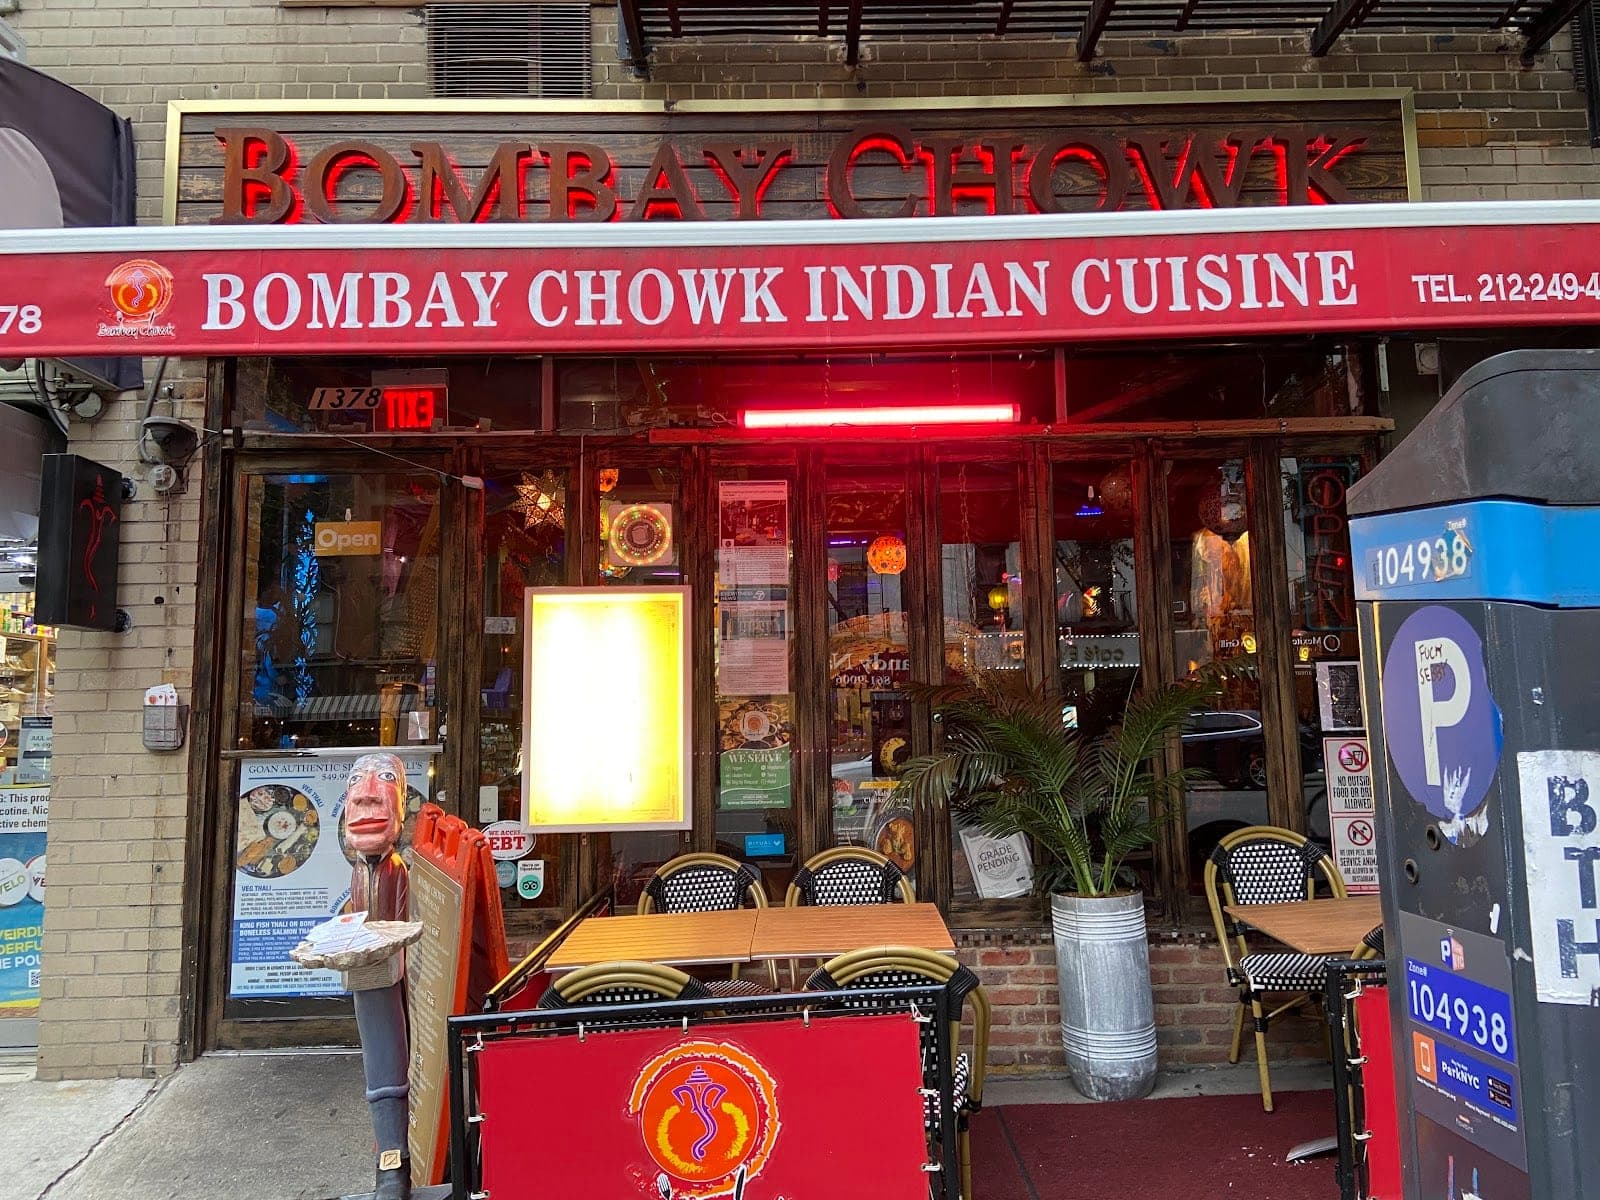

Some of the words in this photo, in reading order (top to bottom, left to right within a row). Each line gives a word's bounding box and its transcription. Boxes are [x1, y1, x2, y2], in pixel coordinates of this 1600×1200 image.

[214, 127, 796, 224] BOMBAY
[826, 124, 1368, 218] CHOWK
[201, 270, 508, 331] BOMBAY
[528, 266, 788, 327] CHOWK
[804, 260, 1051, 323] INDIAN
[1071, 249, 1358, 316] CUISINE
[1411, 273, 1473, 303] TEL.
[1477, 272, 1600, 302] 212-249-4
[317, 388, 381, 409] 1378
[317, 528, 378, 550] Open
[1376, 534, 1468, 587] 104938
[1414, 636, 1472, 786] P
[728, 753, 747, 763] WE
[747, 752, 783, 763] SERVE
[248, 764, 281, 775] GOAN
[280, 762, 341, 774] AUTHENTIC
[406, 762, 423, 770] LI'S
[1337, 775, 1347, 787] NO
[1347, 775, 1370, 787] OUTSID
[9, 793, 25, 803] This
[301, 783, 313, 795] VEG
[311, 789, 325, 808] THALI
[1332, 786, 1349, 798] FOOD
[1350, 786, 1360, 798] OR
[1344, 798, 1372, 809] ALLOWED
[1547, 775, 1597, 837] B
[21, 818, 47, 828] chem
[488, 836, 526, 850] EBT
[979, 845, 1012, 861] GRADE
[1340, 856, 1362, 867] SERVICE
[1362, 855, 1378, 867] ANIM
[977, 852, 1020, 873] PENDING
[239, 928, 271, 937] BONELESS
[272, 928, 298, 936] SALMON
[256, 921, 270, 929] FISH
[289, 920, 298, 928] ON
[1410, 979, 1509, 1055] 104938
[1441, 1060, 1480, 1090] ParkNYC
